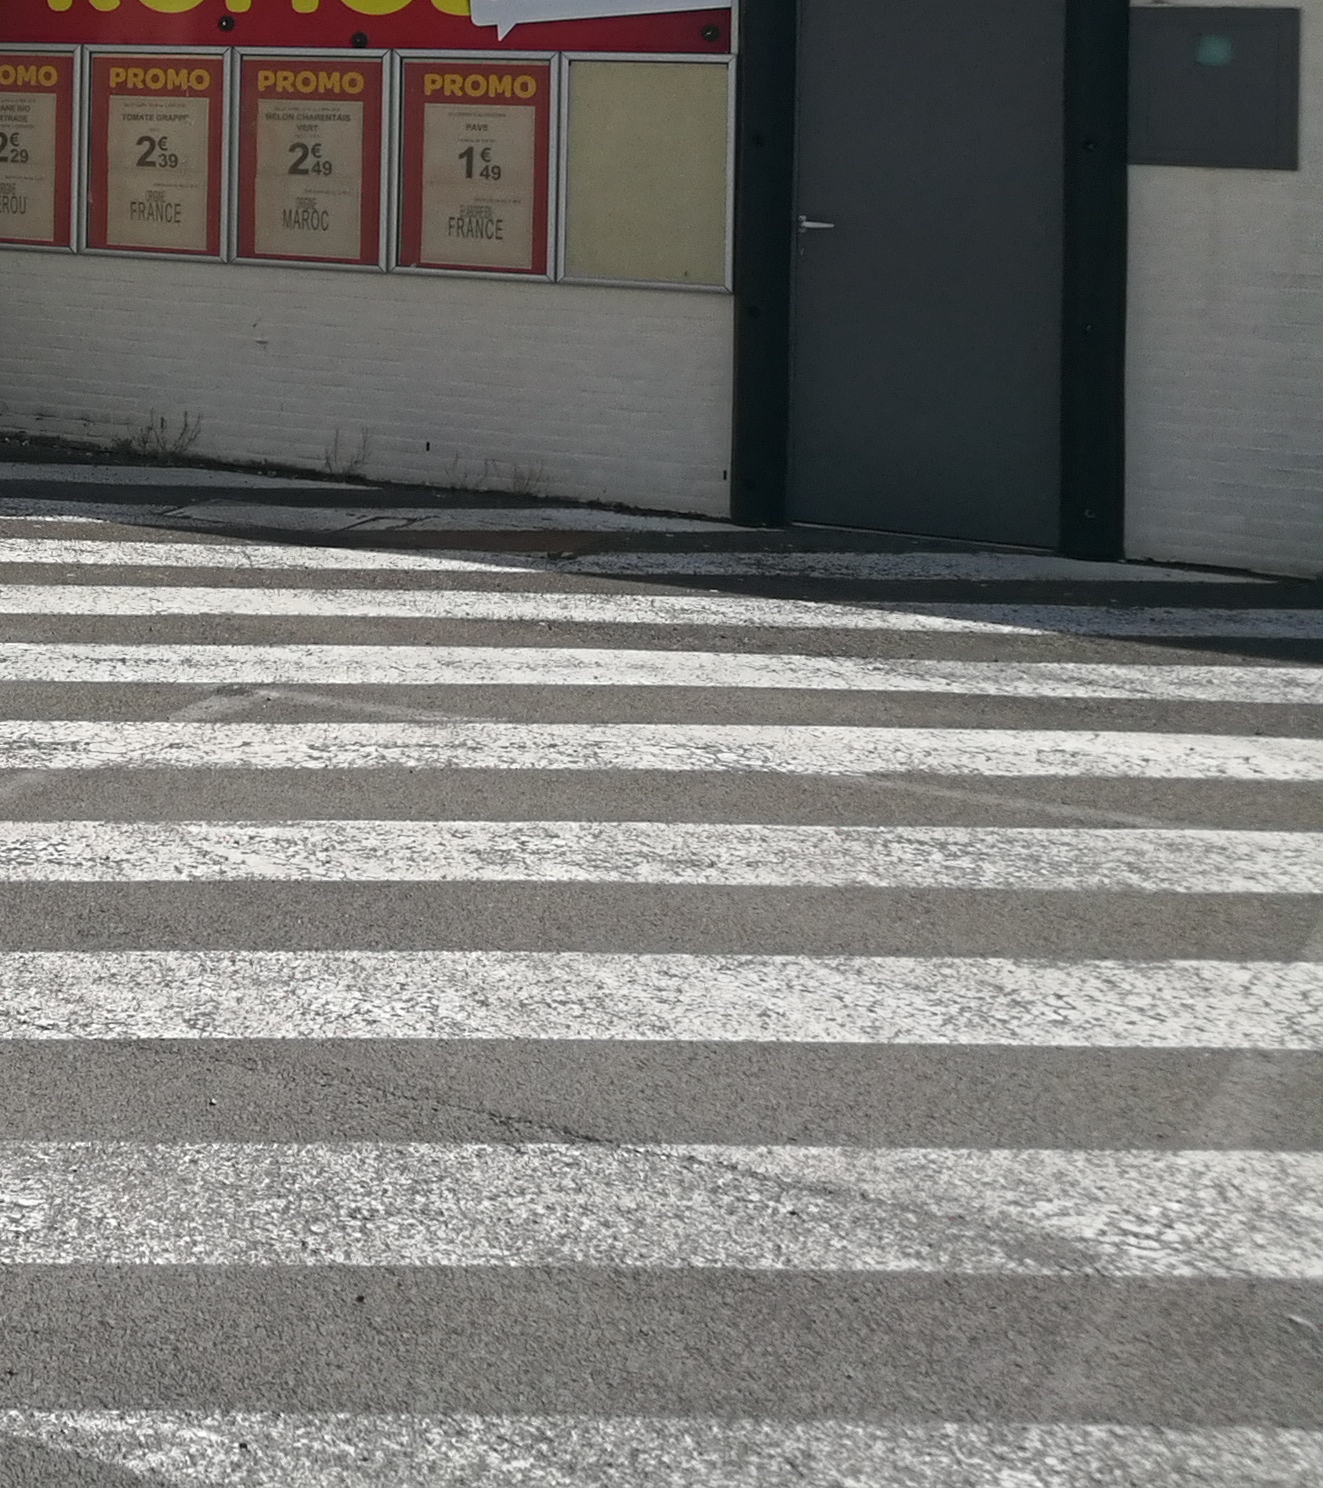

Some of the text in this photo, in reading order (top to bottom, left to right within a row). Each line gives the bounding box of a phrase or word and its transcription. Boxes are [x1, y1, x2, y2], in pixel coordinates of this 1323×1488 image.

[109, 67, 211, 91] PROMO
[258, 70, 365, 94] PROMO
[423, 73, 537, 99] PROMO
[122, 113, 154, 121] TOMATE
[265, 112, 351, 122] MELON CHARENTAIS
[130, 201, 182, 223] FRANCE
[282, 208, 330, 231] MAROC
[448, 216, 504, 240] FRANCE
